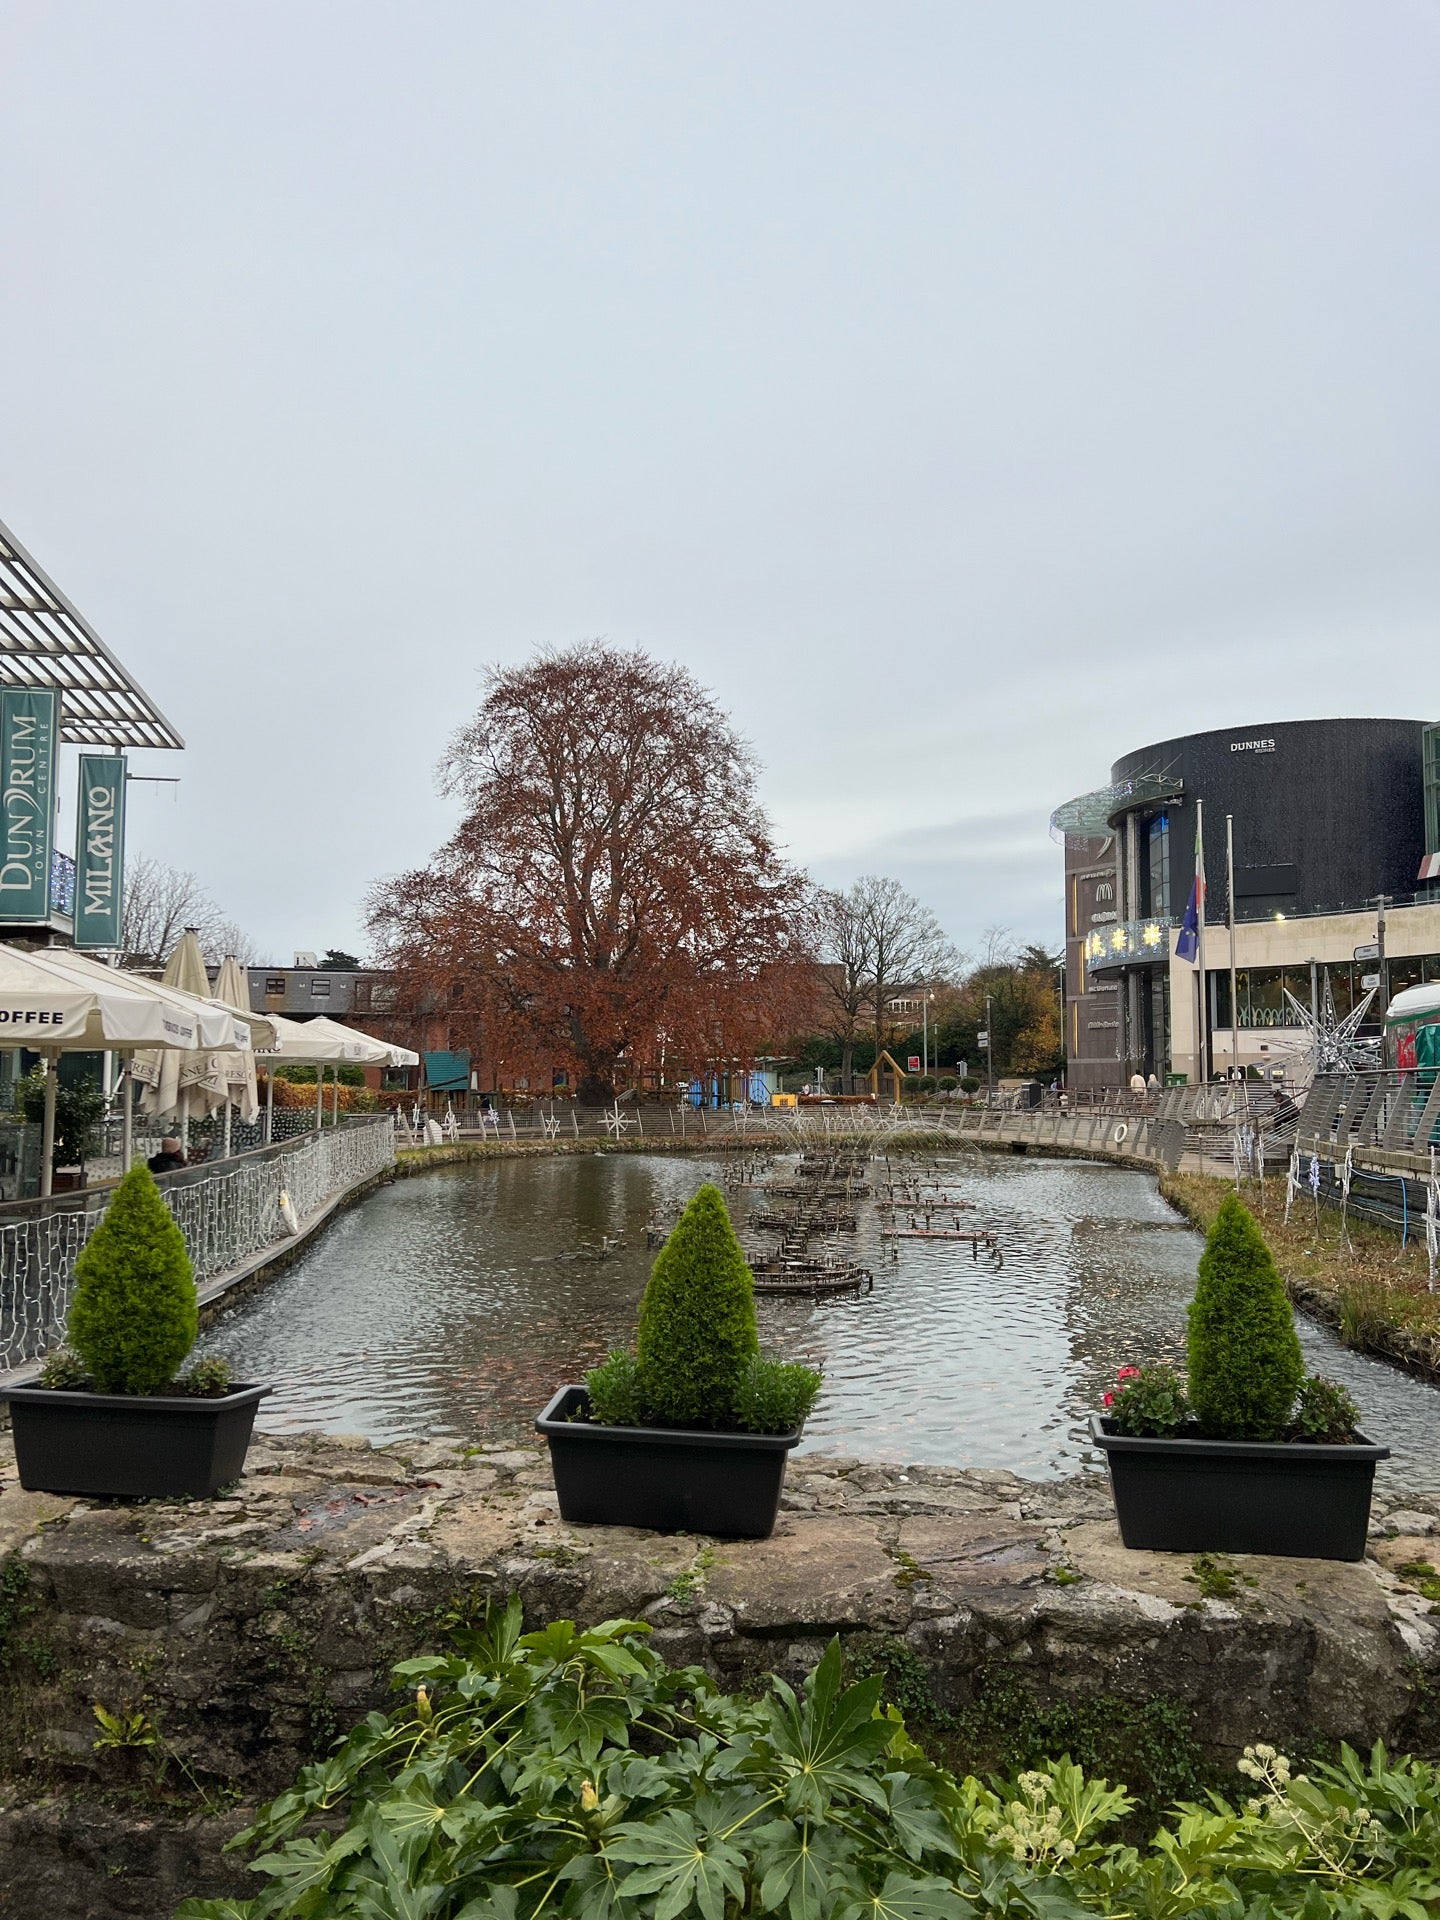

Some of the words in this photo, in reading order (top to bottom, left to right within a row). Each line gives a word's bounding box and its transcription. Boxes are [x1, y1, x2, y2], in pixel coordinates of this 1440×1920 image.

[38, 723, 50, 795] CENTRE
[1230, 738, 1276, 752] DUNNES
[0, 713, 43, 893] DUNDRUM
[35, 829, 45, 882] TOWN
[83, 786, 115, 917] MILANO
